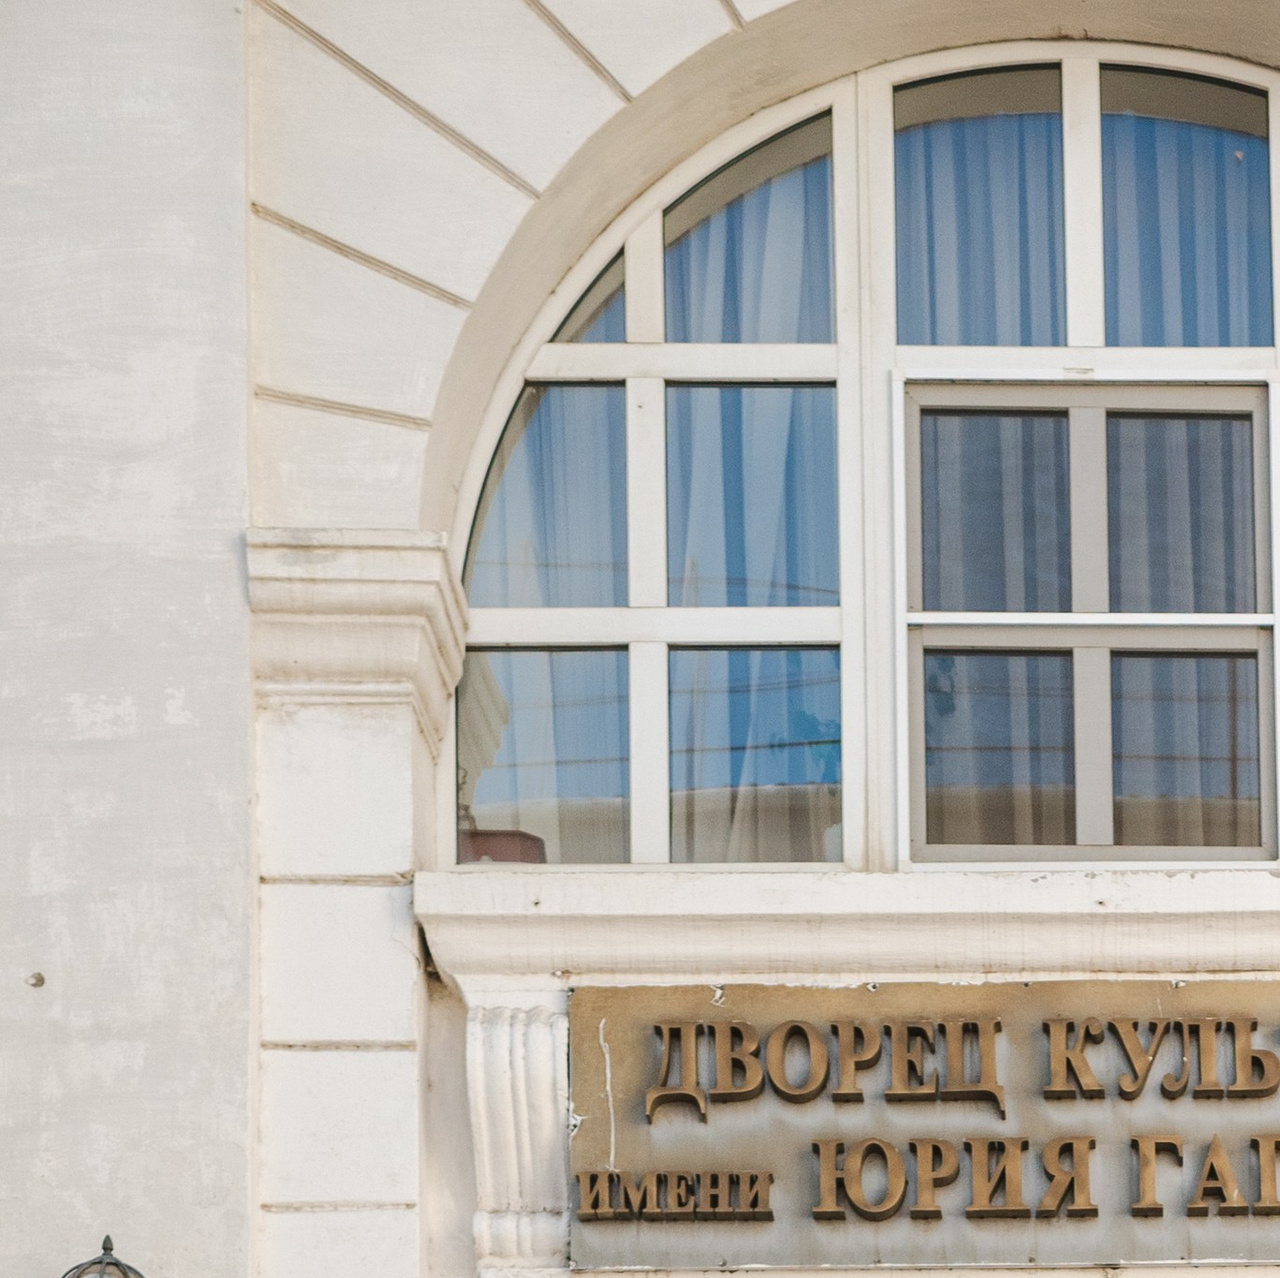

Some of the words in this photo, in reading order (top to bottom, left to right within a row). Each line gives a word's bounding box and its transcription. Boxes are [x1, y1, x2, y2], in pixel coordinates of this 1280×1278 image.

[645, 1018, 1006, 1124] ДВОРЕЦ
[574, 1171, 775, 1223] ИМЕНИ
[811, 1137, 1099, 1222] ЮРИЯ
